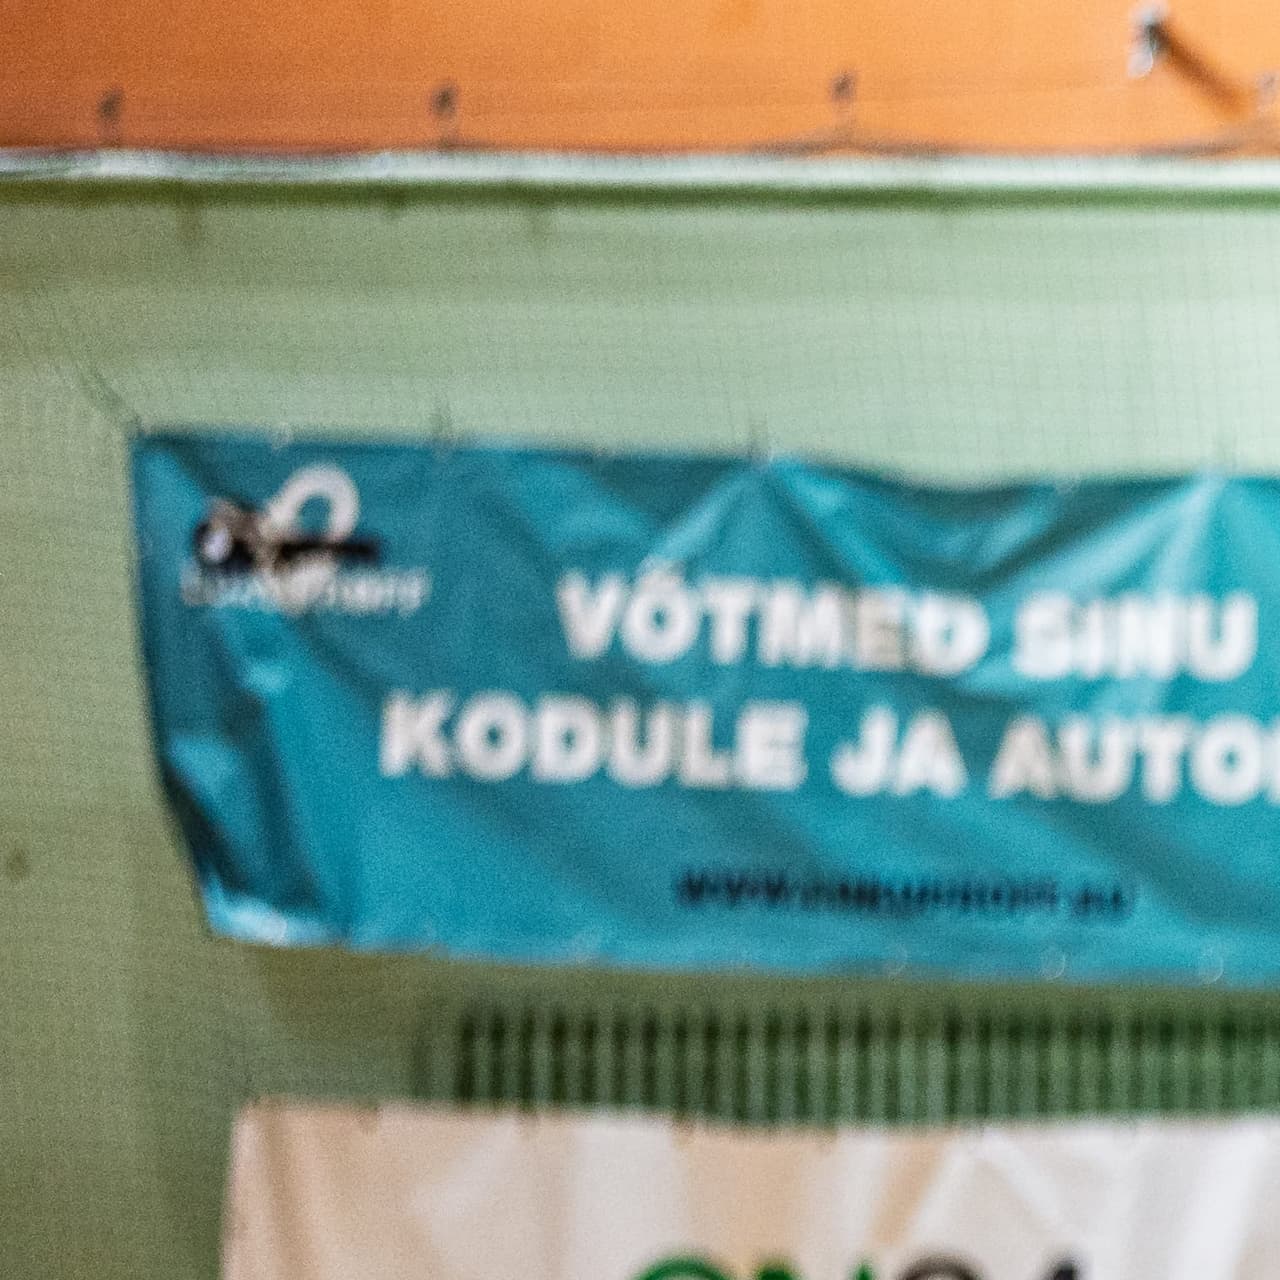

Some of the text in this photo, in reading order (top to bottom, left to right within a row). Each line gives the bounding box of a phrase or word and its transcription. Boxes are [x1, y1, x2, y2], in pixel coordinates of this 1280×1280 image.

[559, 556, 991, 678] VÕTMED
[1013, 591, 1257, 681] SINU
[379, 689, 809, 790] KODULE
[829, 707, 967, 799] JA
